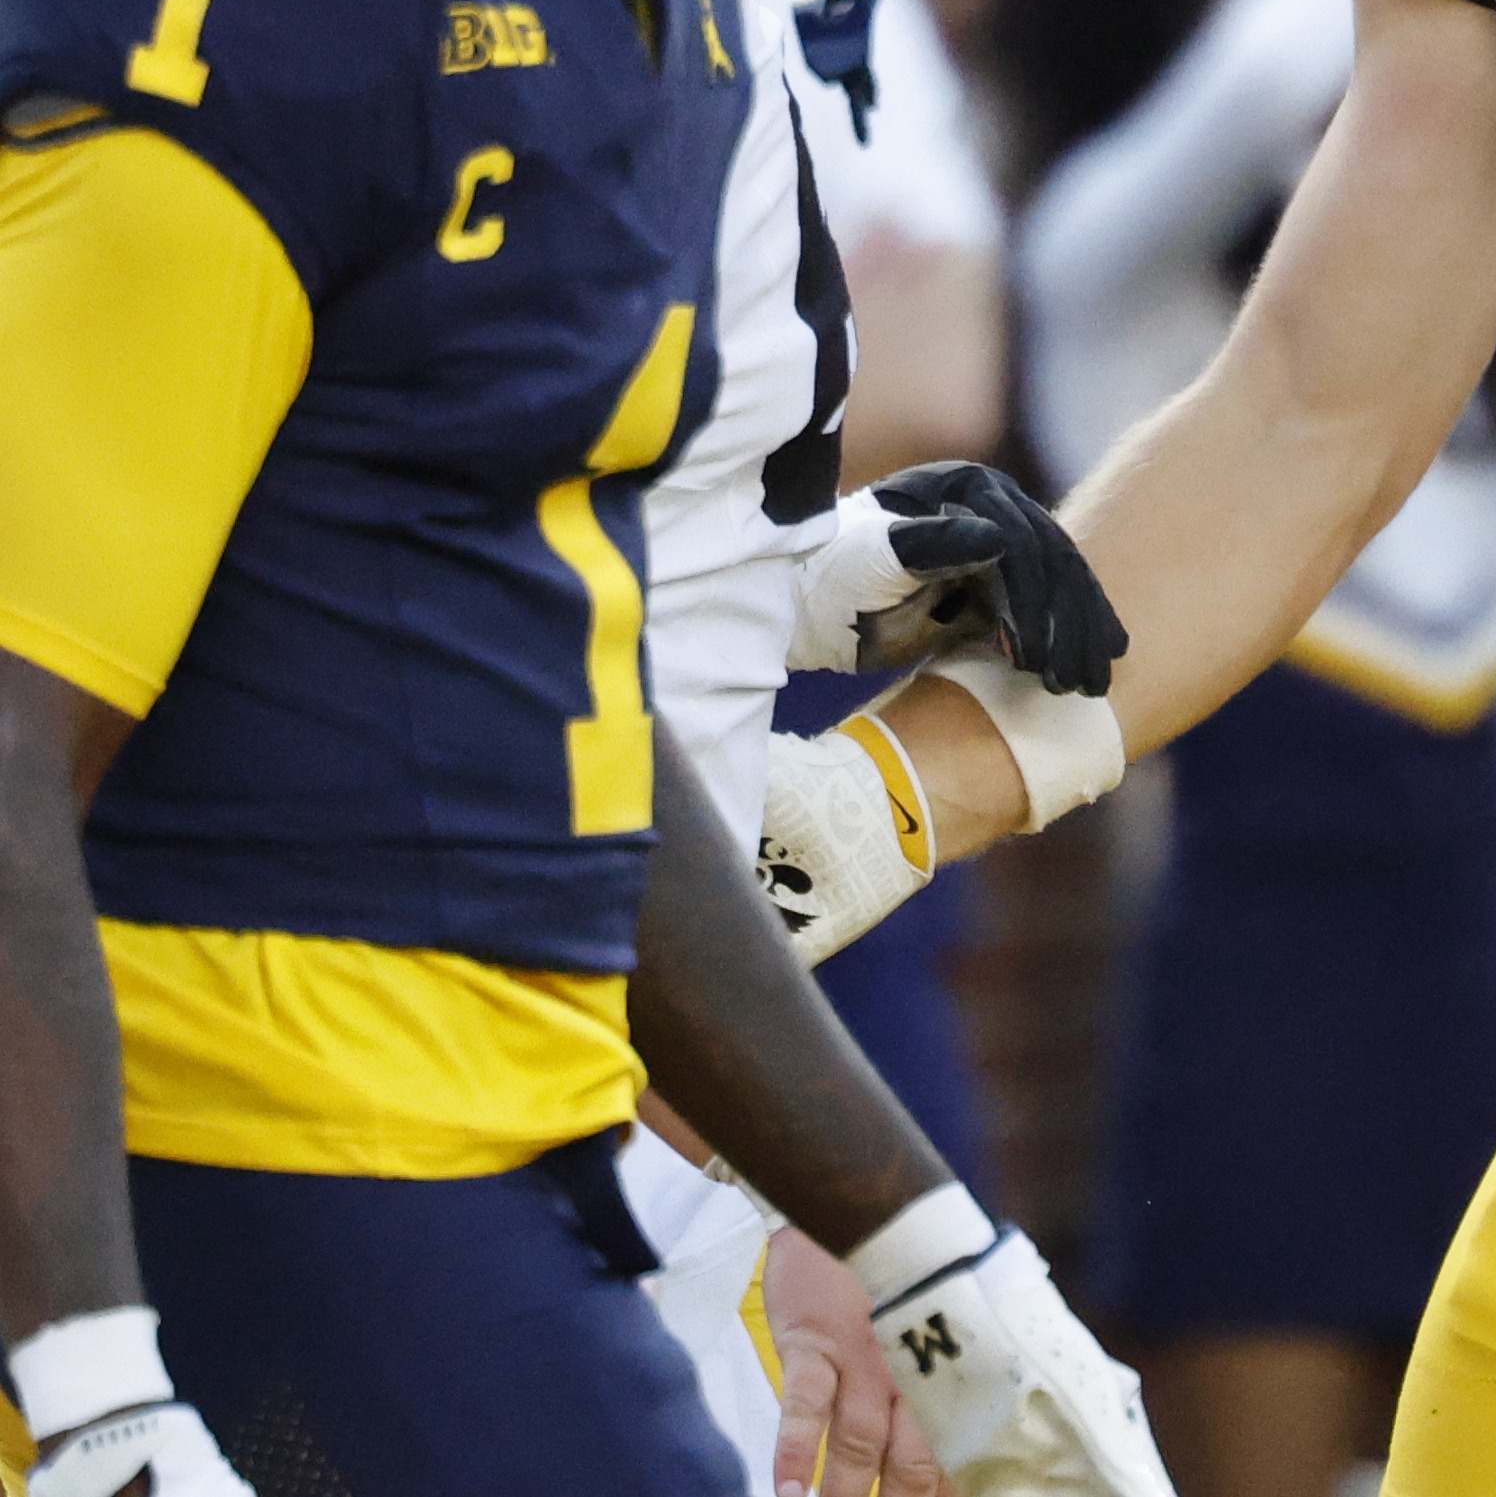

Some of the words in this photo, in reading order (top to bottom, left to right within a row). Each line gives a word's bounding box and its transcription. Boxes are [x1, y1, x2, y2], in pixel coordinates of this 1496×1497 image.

[439, 1, 548, 76] BIG
[436, 143, 514, 264] C
[536, 304, 693, 837] 1
